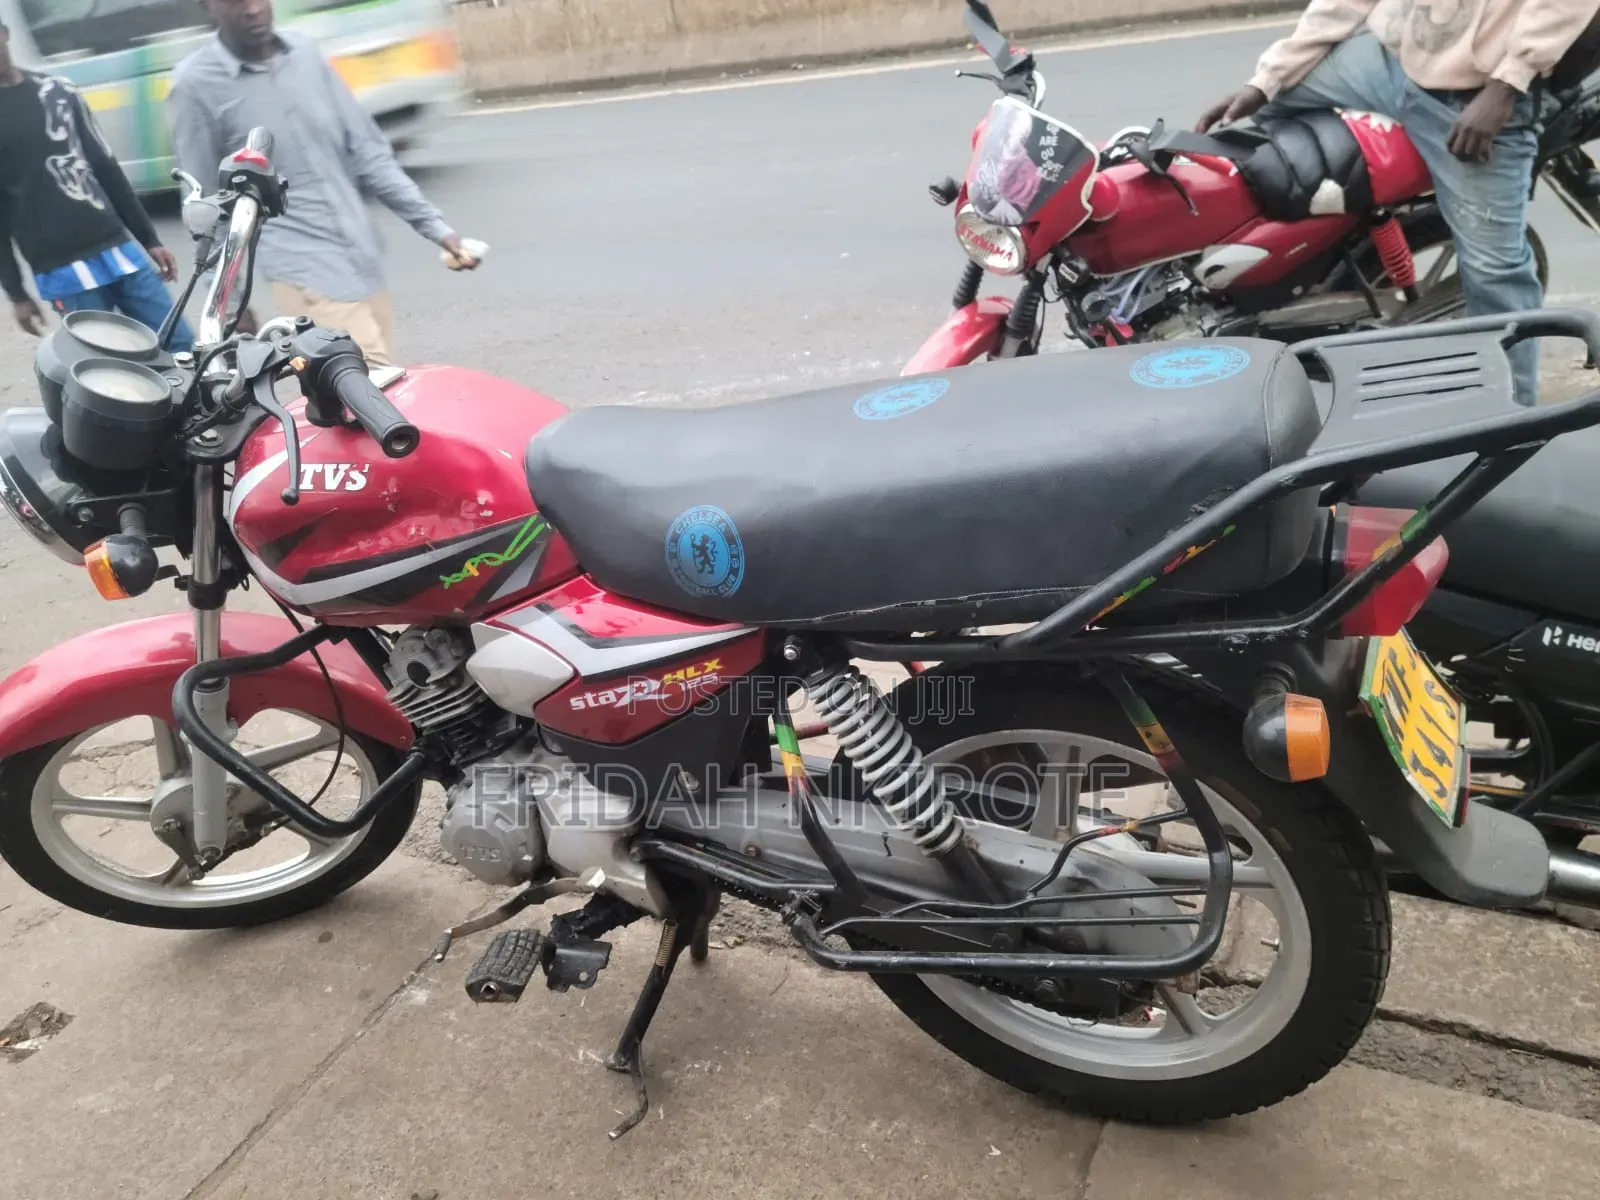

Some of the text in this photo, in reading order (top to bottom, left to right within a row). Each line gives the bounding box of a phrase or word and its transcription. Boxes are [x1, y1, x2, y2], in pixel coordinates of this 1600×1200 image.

[299, 463, 369, 491] TVS
[675, 510, 727, 534] CHELSEA
[663, 657, 727, 685] HLX
